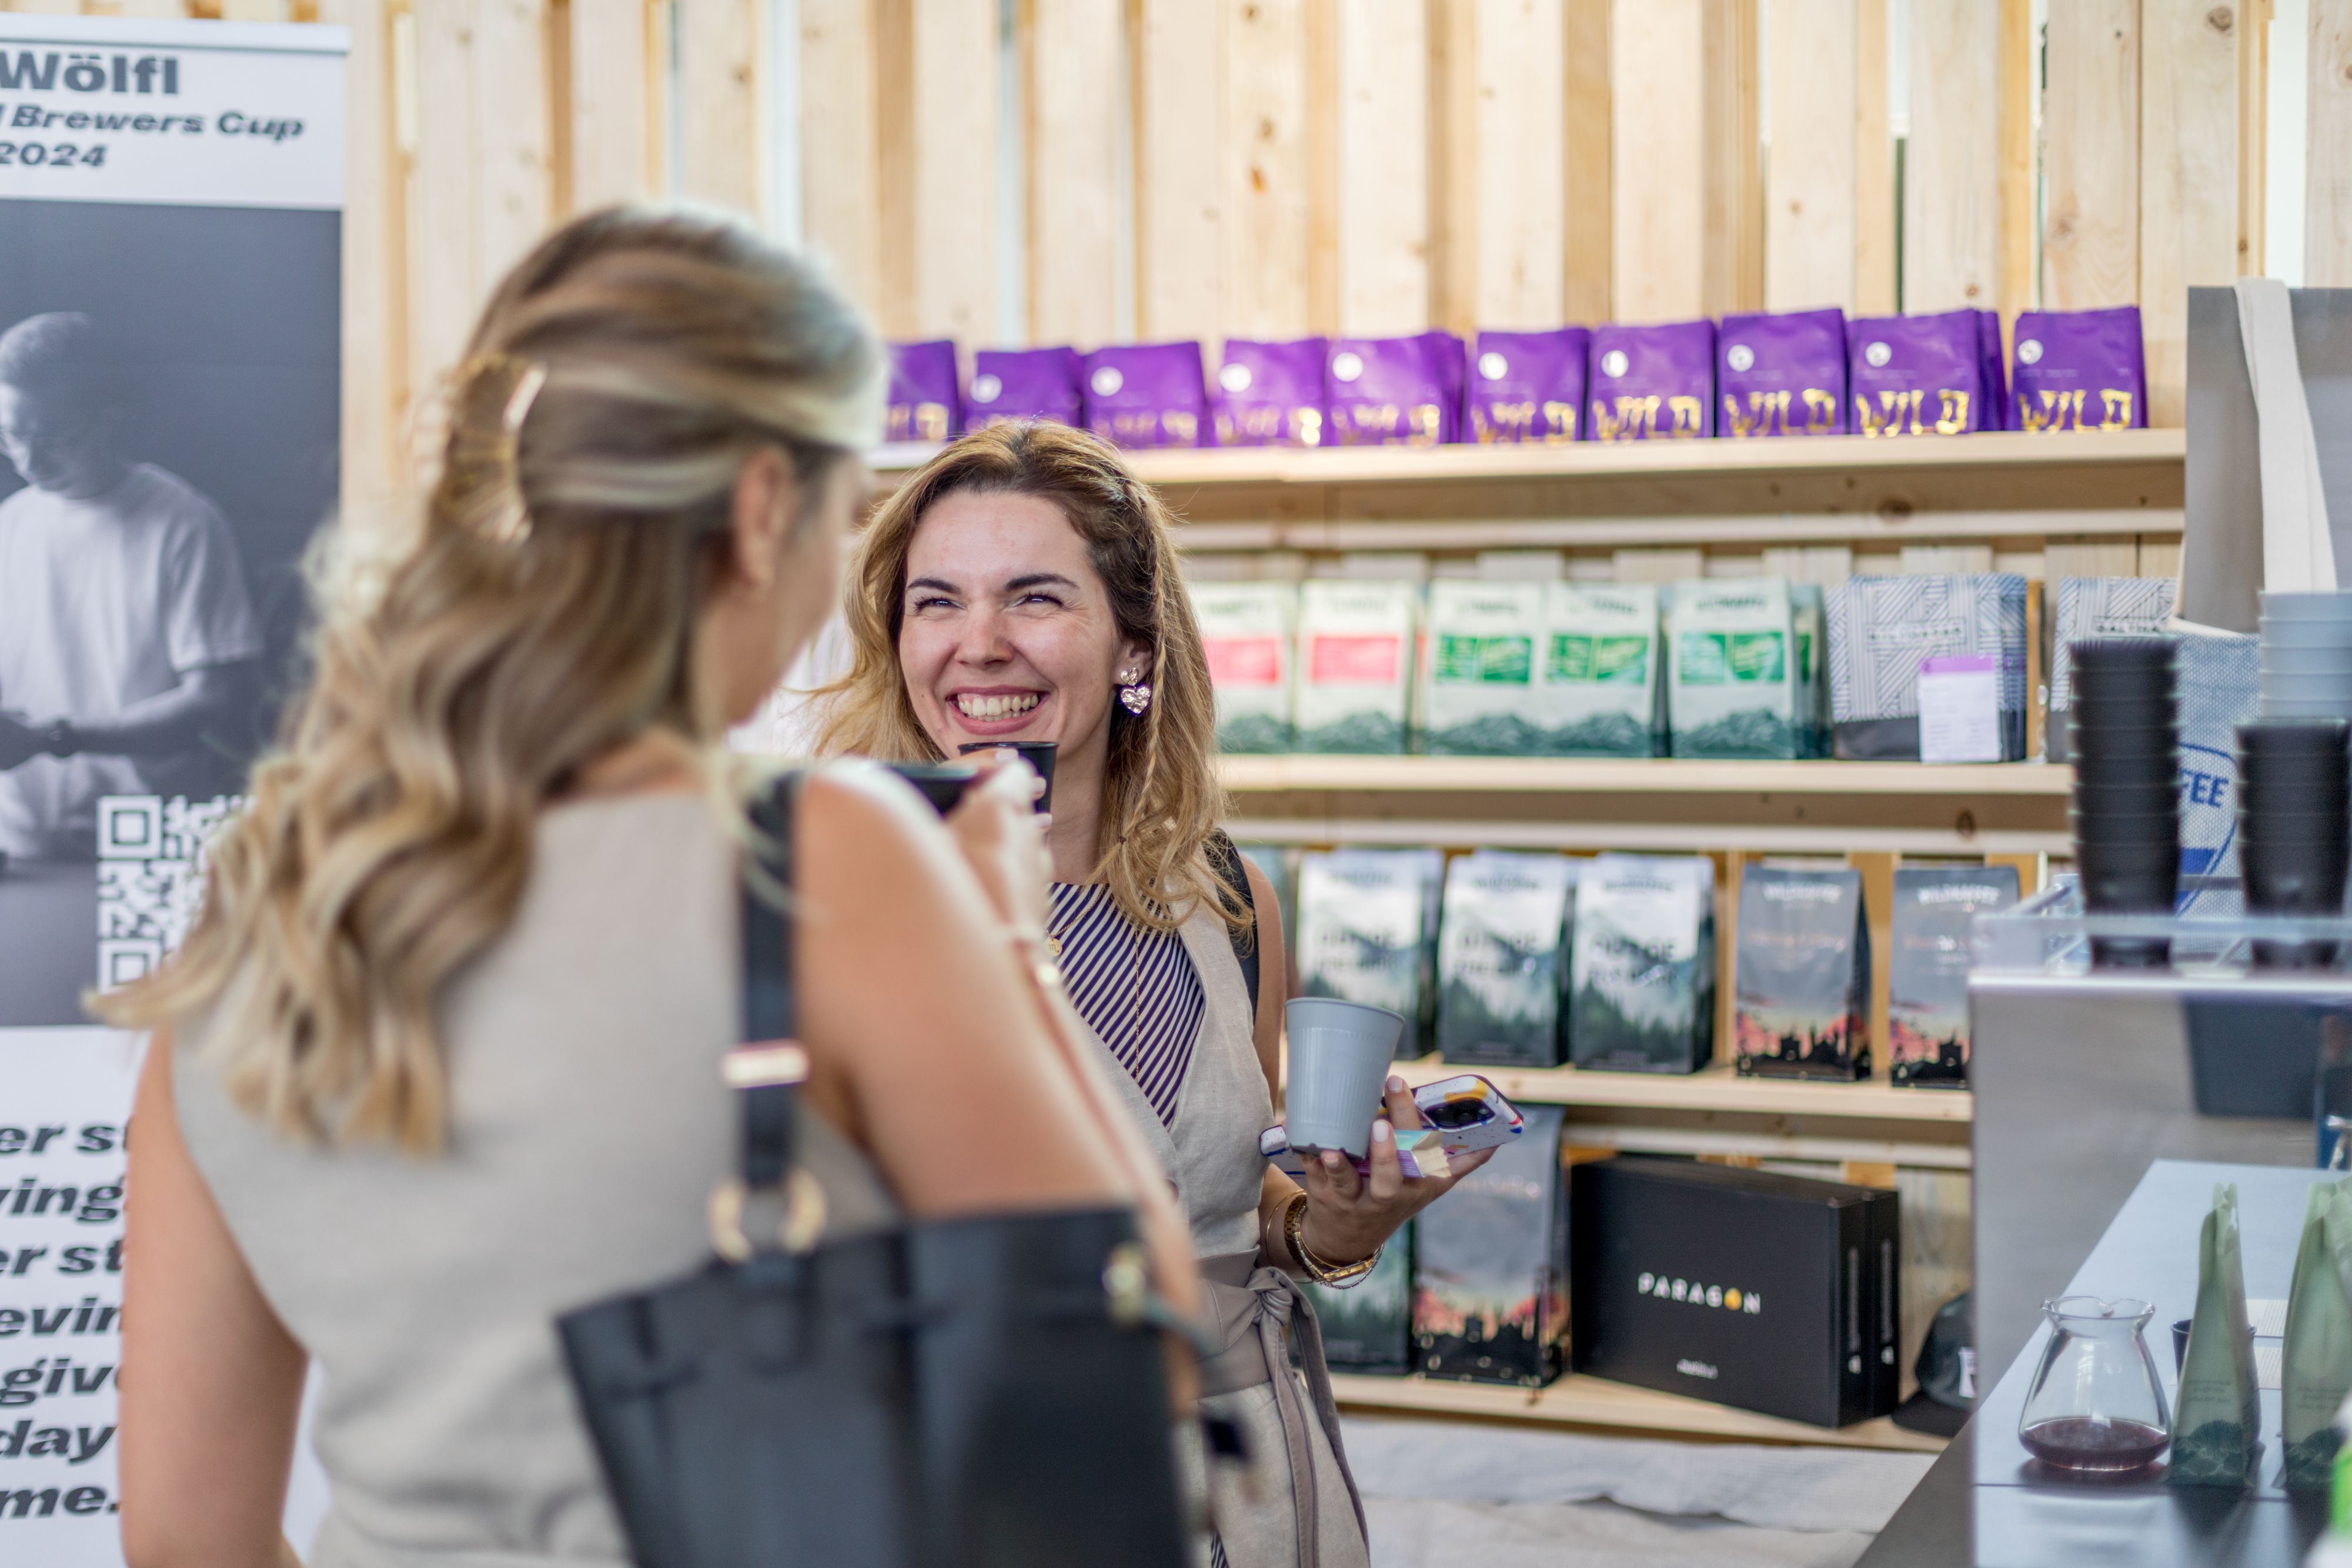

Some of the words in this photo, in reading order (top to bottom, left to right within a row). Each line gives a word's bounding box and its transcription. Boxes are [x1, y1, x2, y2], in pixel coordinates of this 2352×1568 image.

[0, 51, 179, 95] Wölfl
[11, 104, 203, 133] Brewers
[218, 111, 304, 141] Cup
[0, 142, 108, 167] 2024
[1638, 1272, 1761, 1315] PARAGON
[0, 1358, 121, 1406] giv
